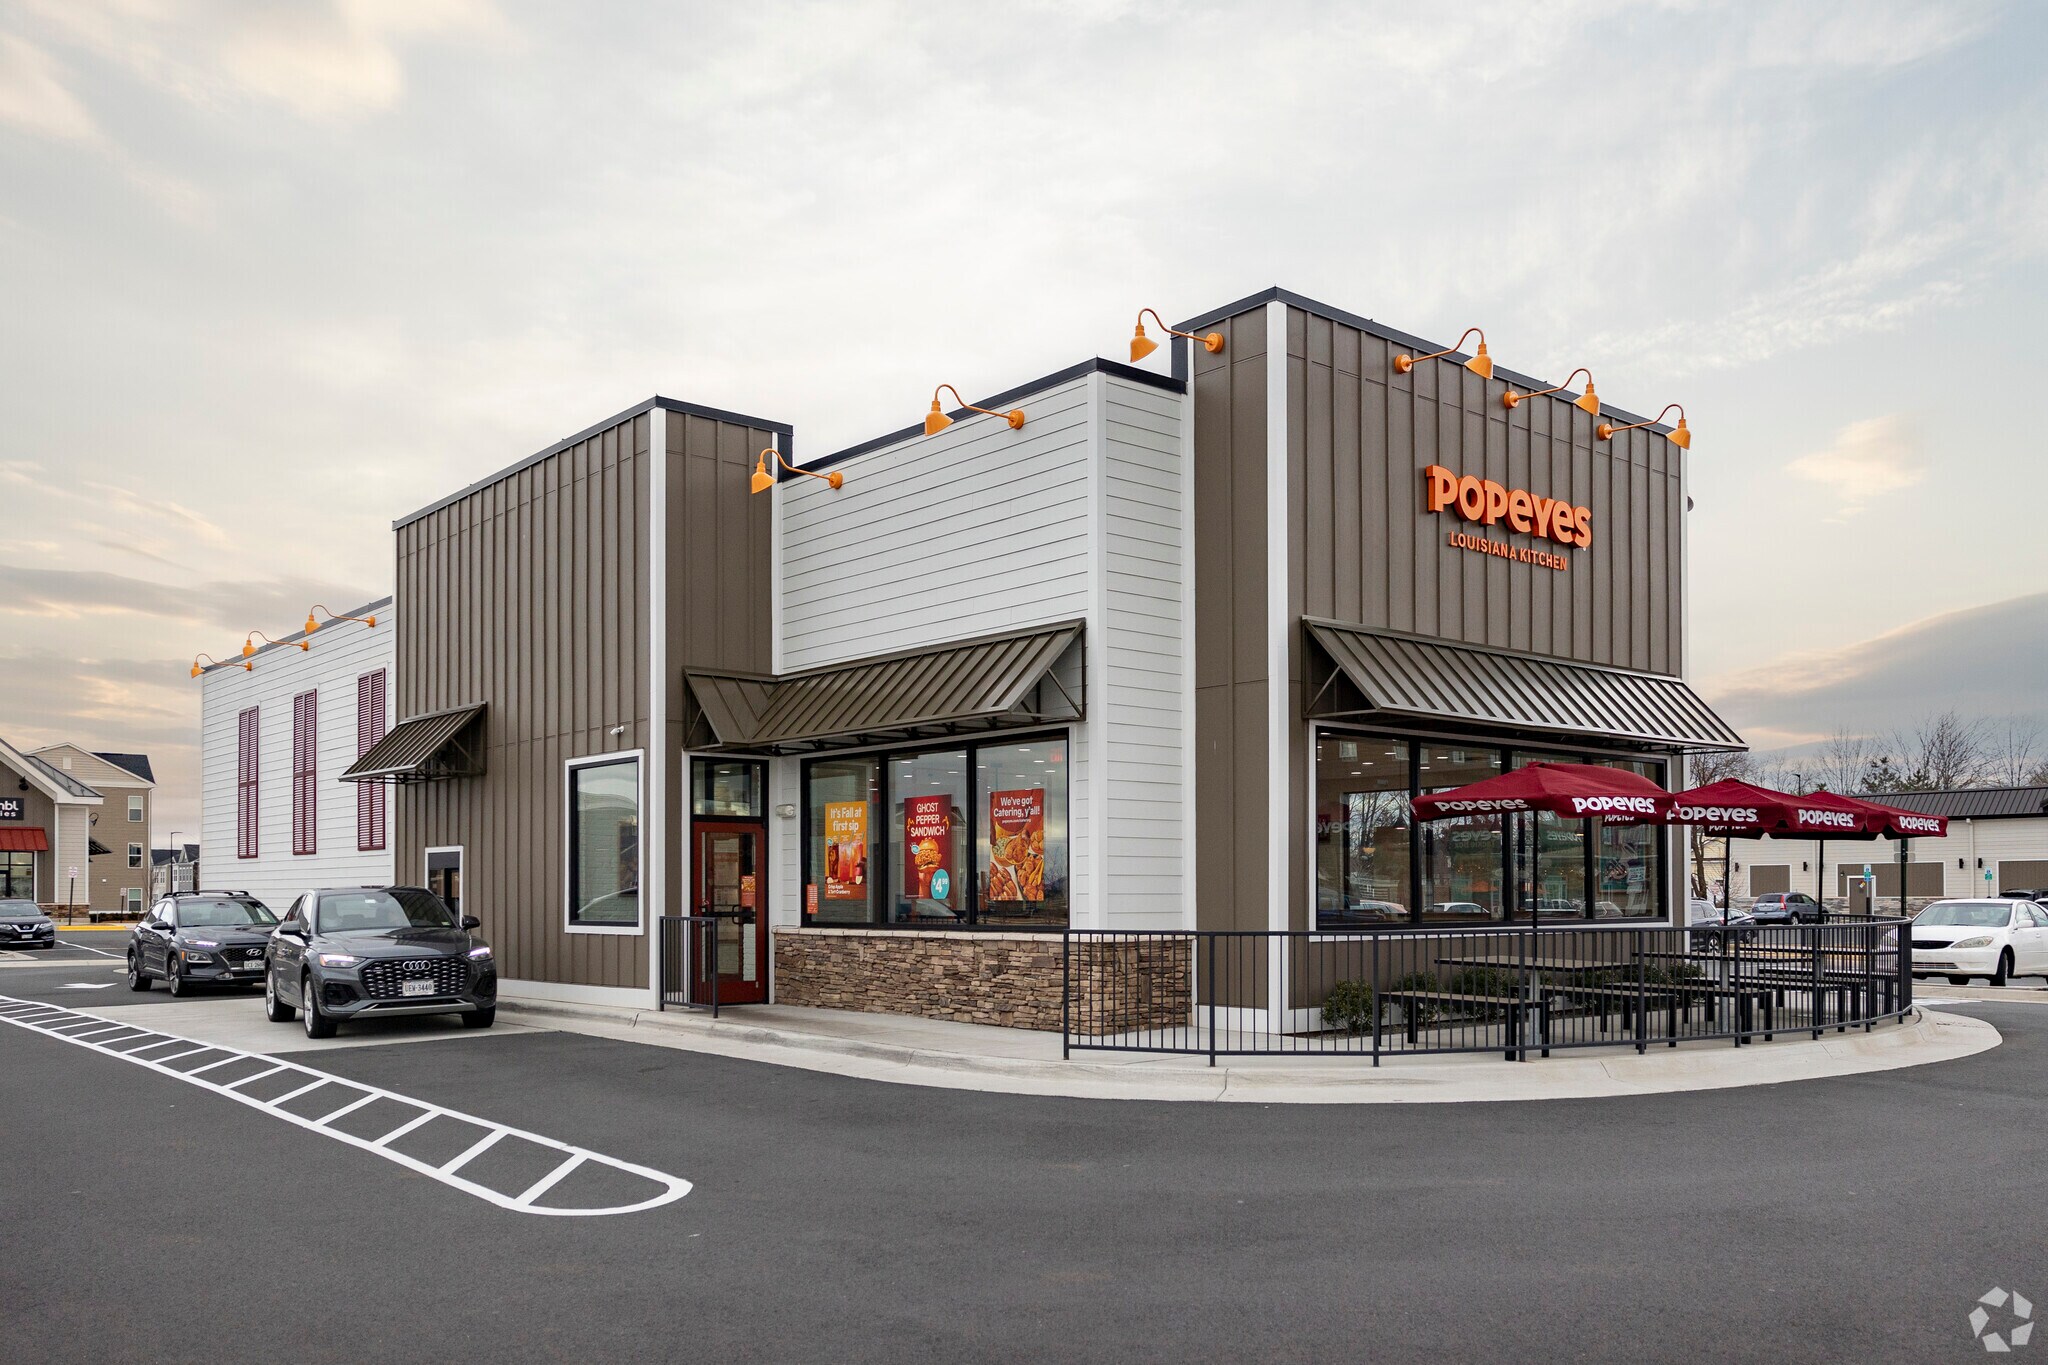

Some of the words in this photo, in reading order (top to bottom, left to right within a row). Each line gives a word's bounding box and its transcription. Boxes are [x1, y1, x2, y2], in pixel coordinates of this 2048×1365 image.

[1449, 531, 1517, 561] LOUISIANA
[1519, 547, 1568, 571] KITCHEN
[1000, 796, 1020, 806] We've
[1021, 796, 1033, 807] got
[830, 808, 841, 818] It's
[841, 807, 854, 818] Fall
[854, 807, 862, 818] at
[916, 802, 938, 813] GHOST
[993, 807, 1024, 818] Catering,
[1025, 806, 1040, 817] y'all!
[915, 814, 940, 825] PEPPER
[833, 820, 848, 831] first
[848, 819, 859, 833] sip
[910, 826, 945, 837] SANDWICH
